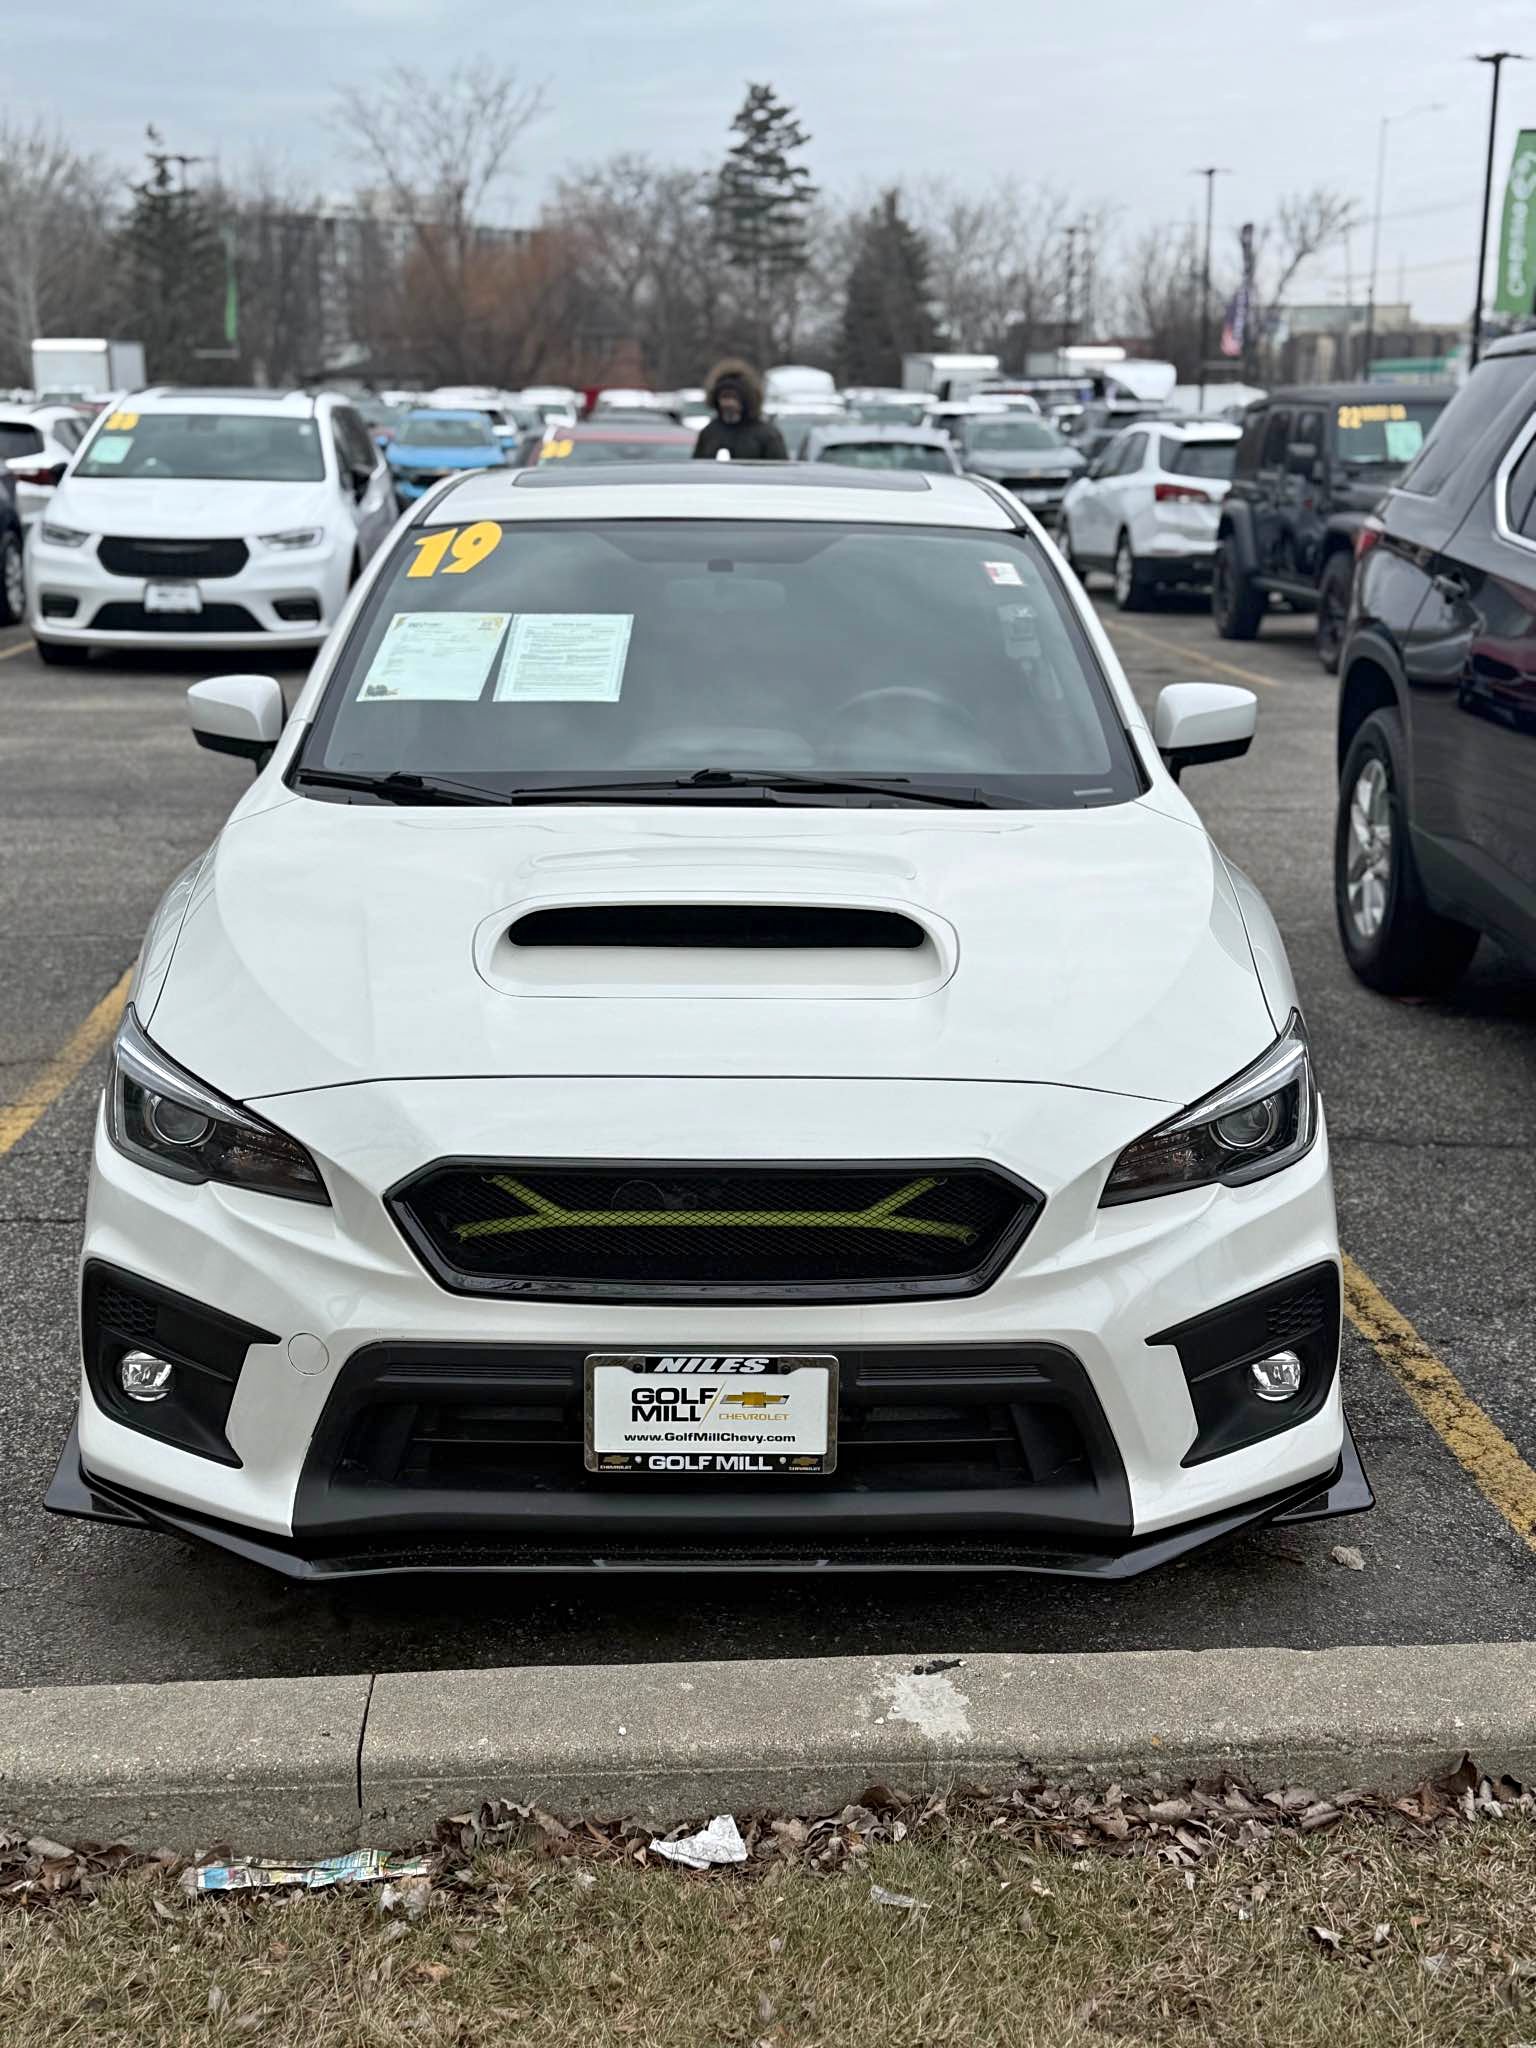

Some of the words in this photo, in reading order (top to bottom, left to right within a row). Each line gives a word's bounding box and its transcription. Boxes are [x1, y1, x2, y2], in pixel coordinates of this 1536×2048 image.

[406, 521, 503, 577] 19
[653, 1358, 769, 1373] NILES
[631, 1387, 718, 1405] GOLF
[631, 1405, 702, 1422] MILL
[719, 1413, 790, 1421] CHEVROLET
[624, 1432, 796, 1444] www.GolfMillChevy.com
[649, 1456, 712, 1470] GOLF
[716, 1456, 773, 1471] MILL
